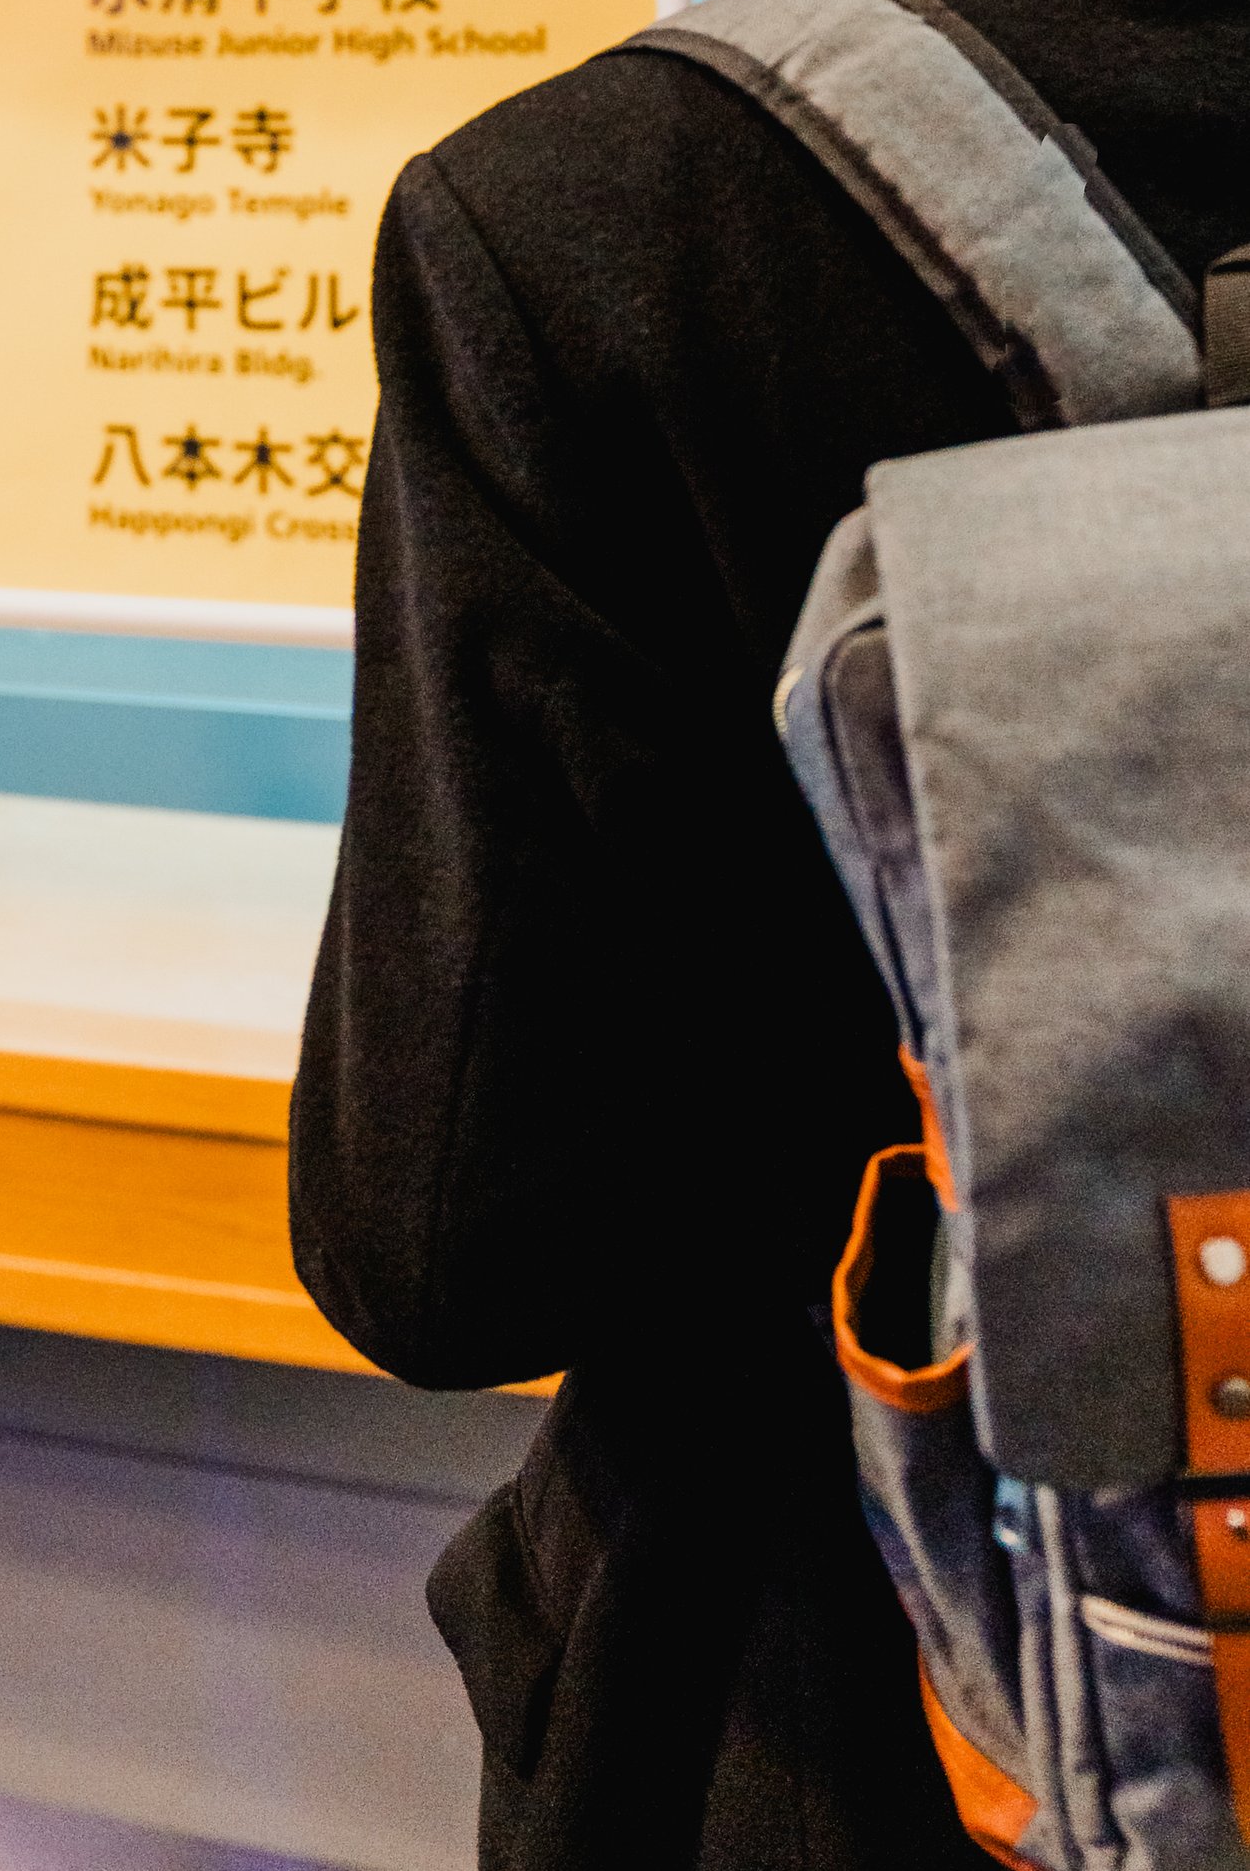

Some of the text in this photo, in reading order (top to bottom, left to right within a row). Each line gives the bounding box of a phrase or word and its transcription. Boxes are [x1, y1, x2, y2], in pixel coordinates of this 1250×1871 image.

[216, 28, 321, 55] Junior
[332, 26, 415, 64] High
[426, 26, 548, 56] School
[89, 105, 293, 173] 米子寺
[89, 189, 349, 222] Yonago Temple
[90, 265, 359, 330] 成平ビル
